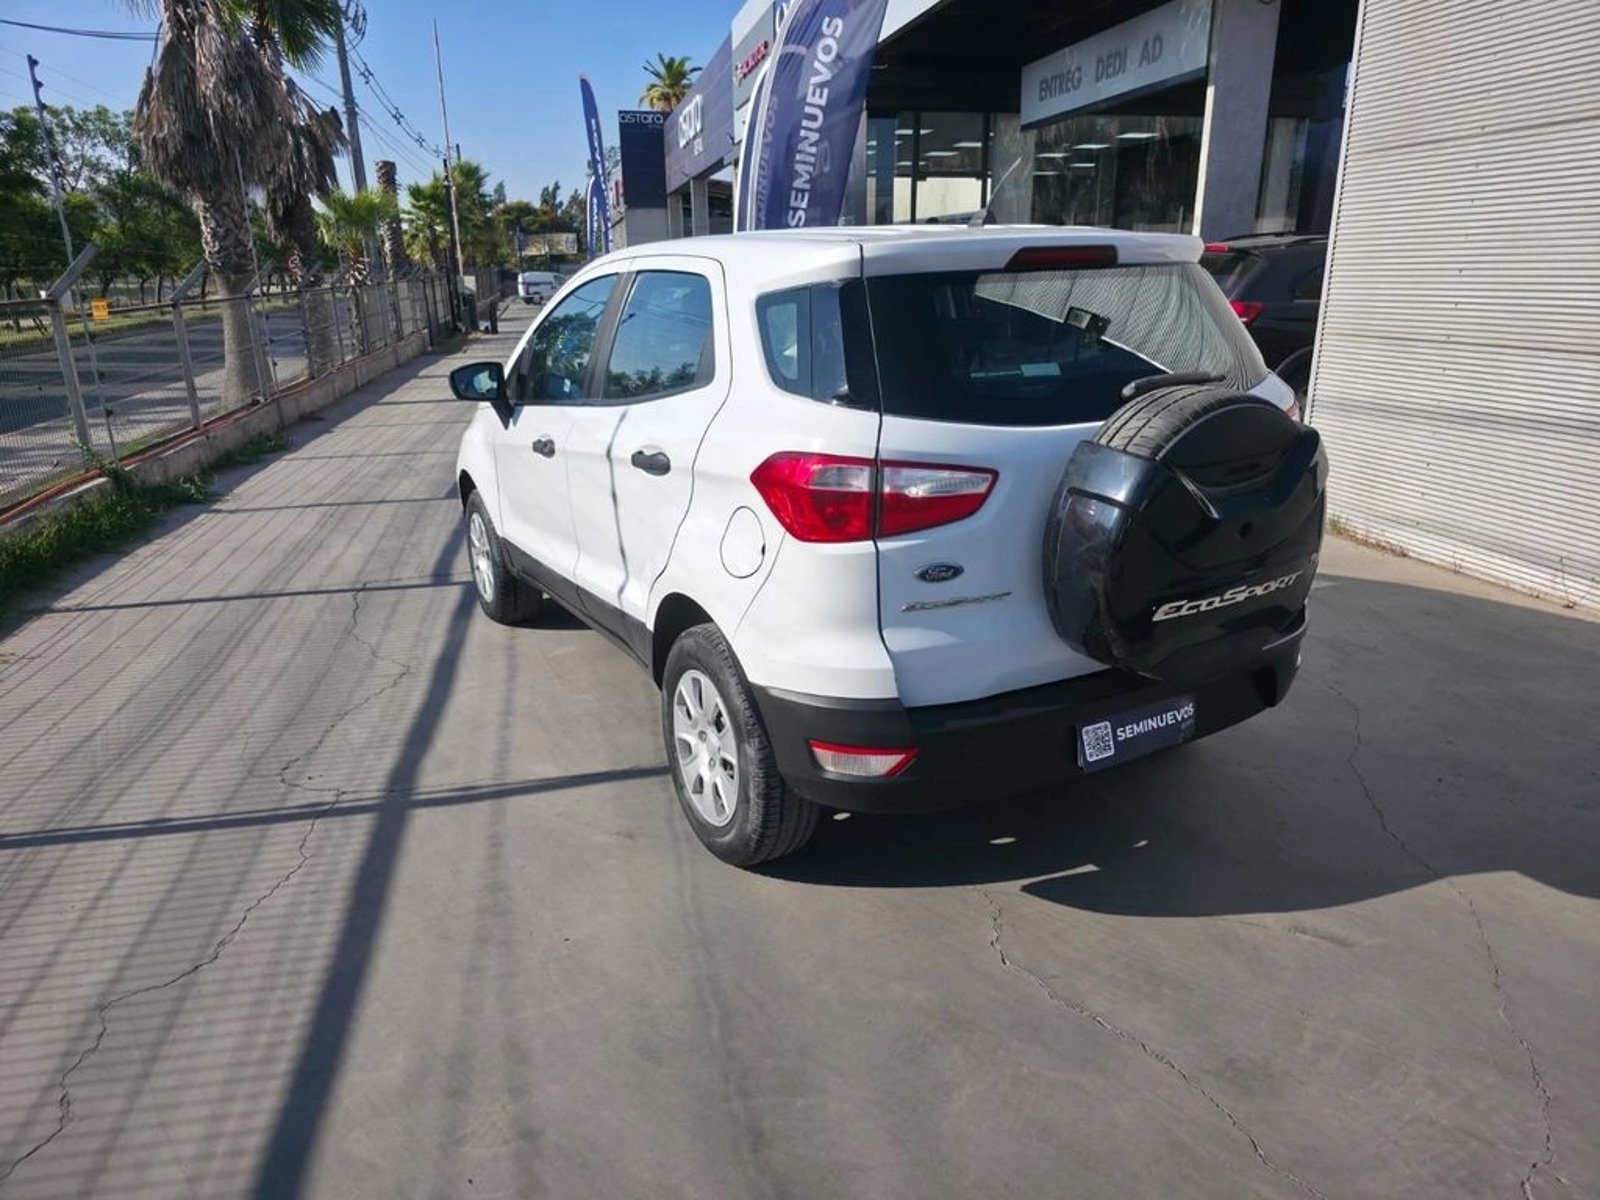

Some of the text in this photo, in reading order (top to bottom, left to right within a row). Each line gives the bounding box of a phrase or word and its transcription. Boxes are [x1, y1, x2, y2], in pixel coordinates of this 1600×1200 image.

[787, 15, 844, 228] SEMINUEVOS
[1095, 47, 1128, 83] DEDI
[1139, 35, 1163, 67] AD
